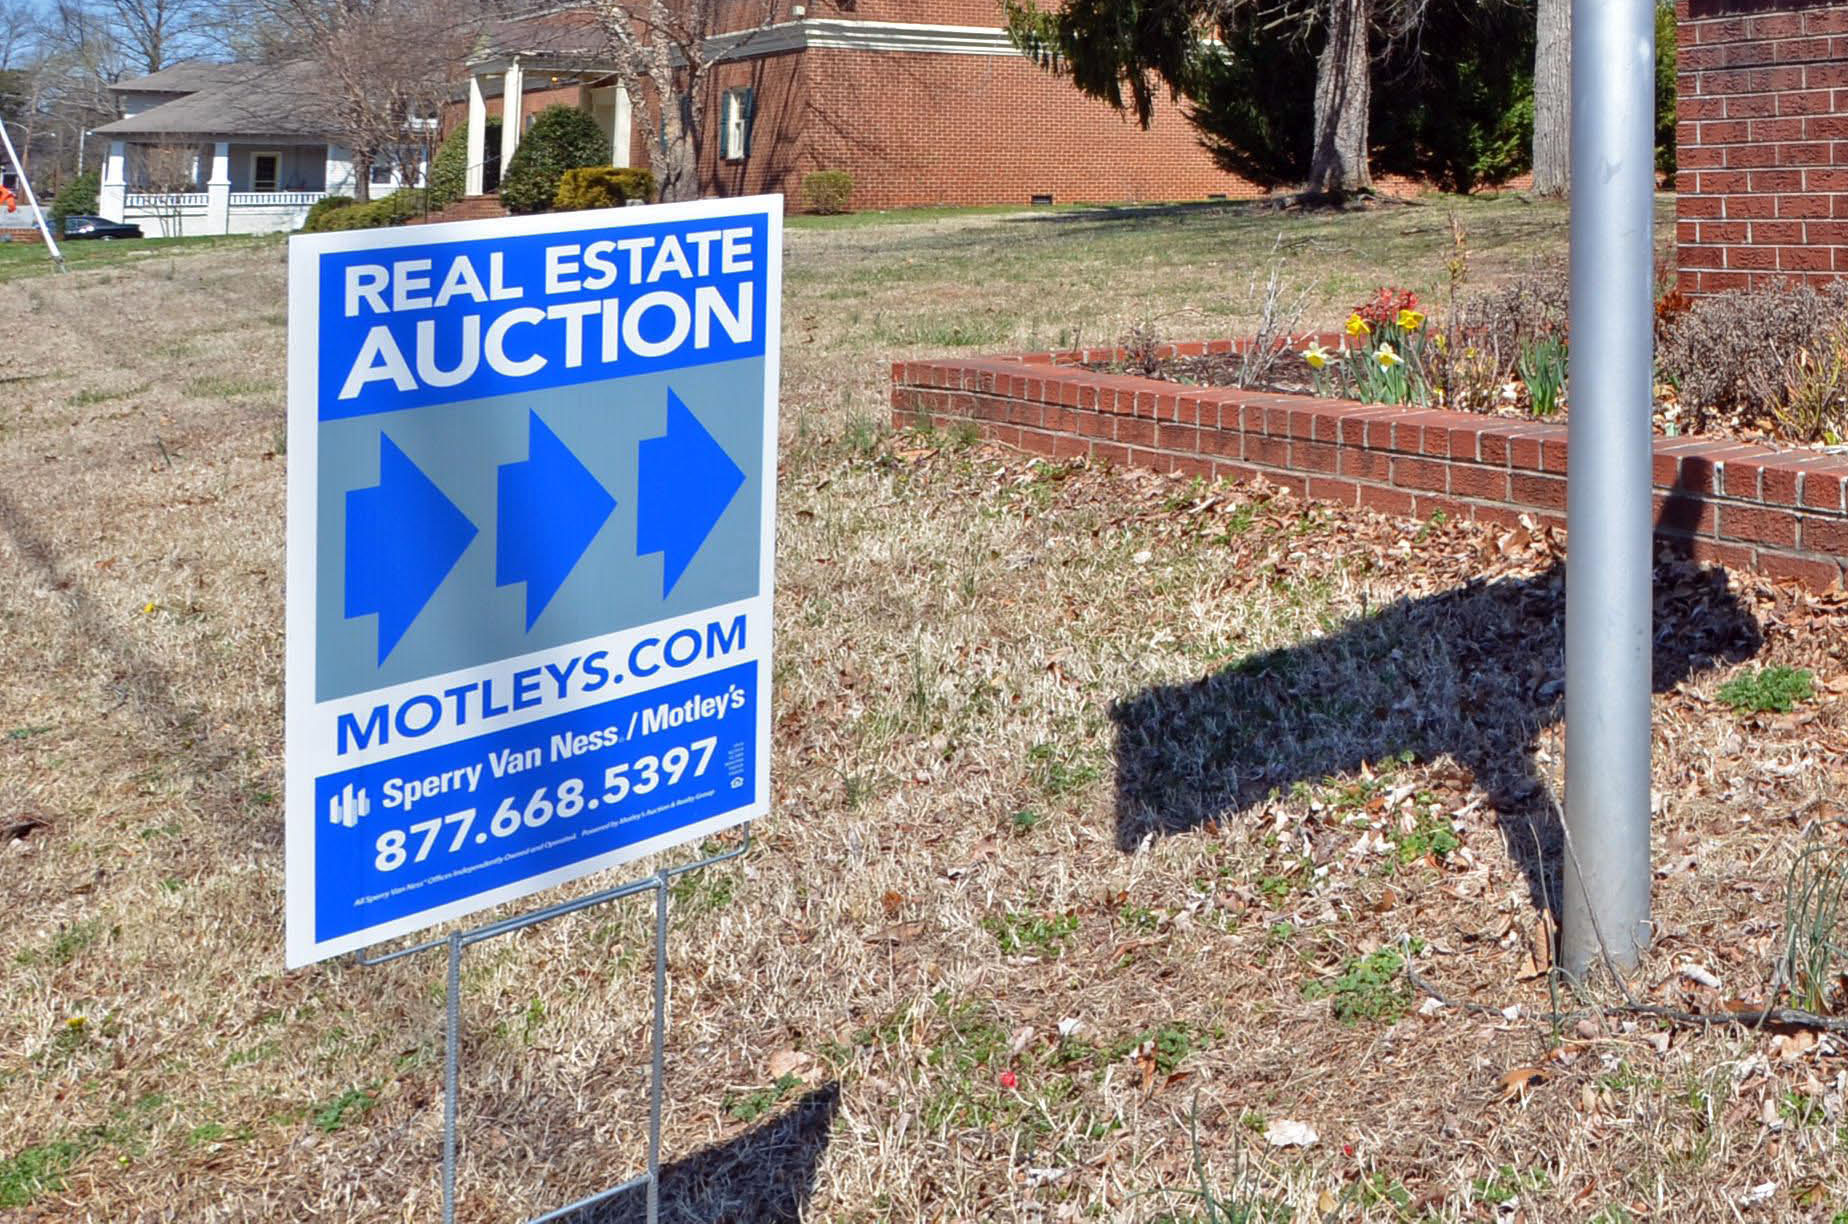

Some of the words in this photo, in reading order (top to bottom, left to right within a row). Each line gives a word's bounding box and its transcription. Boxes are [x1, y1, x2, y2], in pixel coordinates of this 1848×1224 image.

[345, 251, 524, 317] REAL
[545, 226, 754, 295] ESTATE
[338, 281, 755, 400] AUCTION
[337, 614, 748, 756] MOTLEYS.COM
[382, 763, 483, 812] Sperry
[488, 748, 542, 778] Van
[642, 684, 746, 736] Motley's
[375, 735, 719, 872] 877.668.5397
